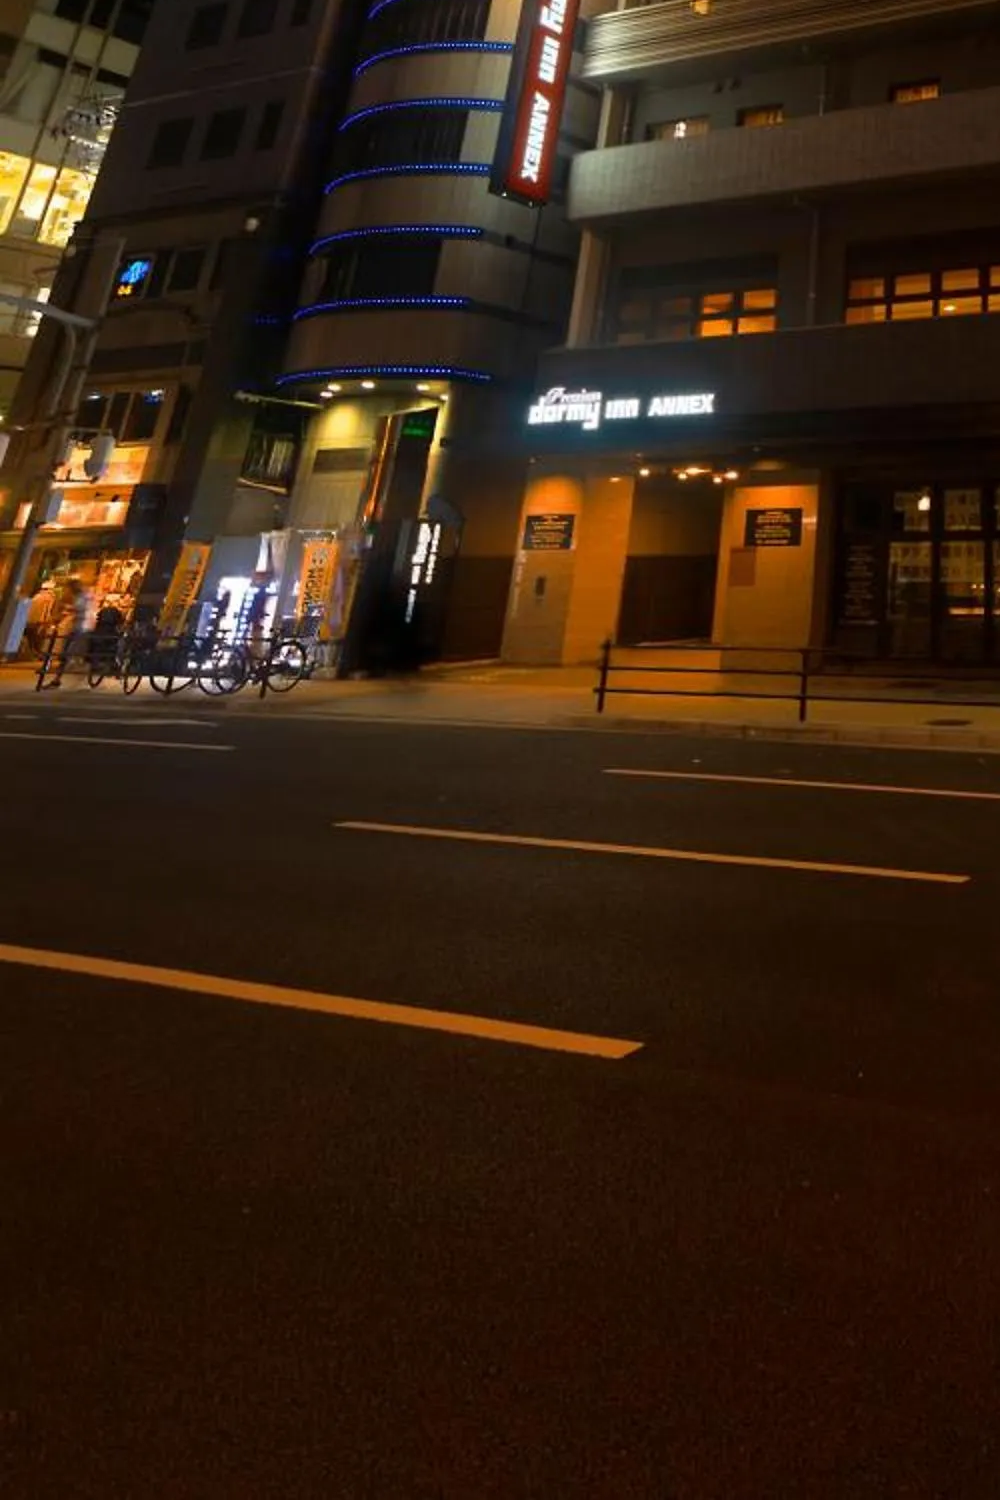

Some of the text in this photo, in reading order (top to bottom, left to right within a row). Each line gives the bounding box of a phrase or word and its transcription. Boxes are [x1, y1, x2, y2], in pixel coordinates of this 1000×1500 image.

[520, 91, 550, 183] ANNEX
[528, 396, 602, 430] dormy
[648, 394, 715, 417] ANNEX
